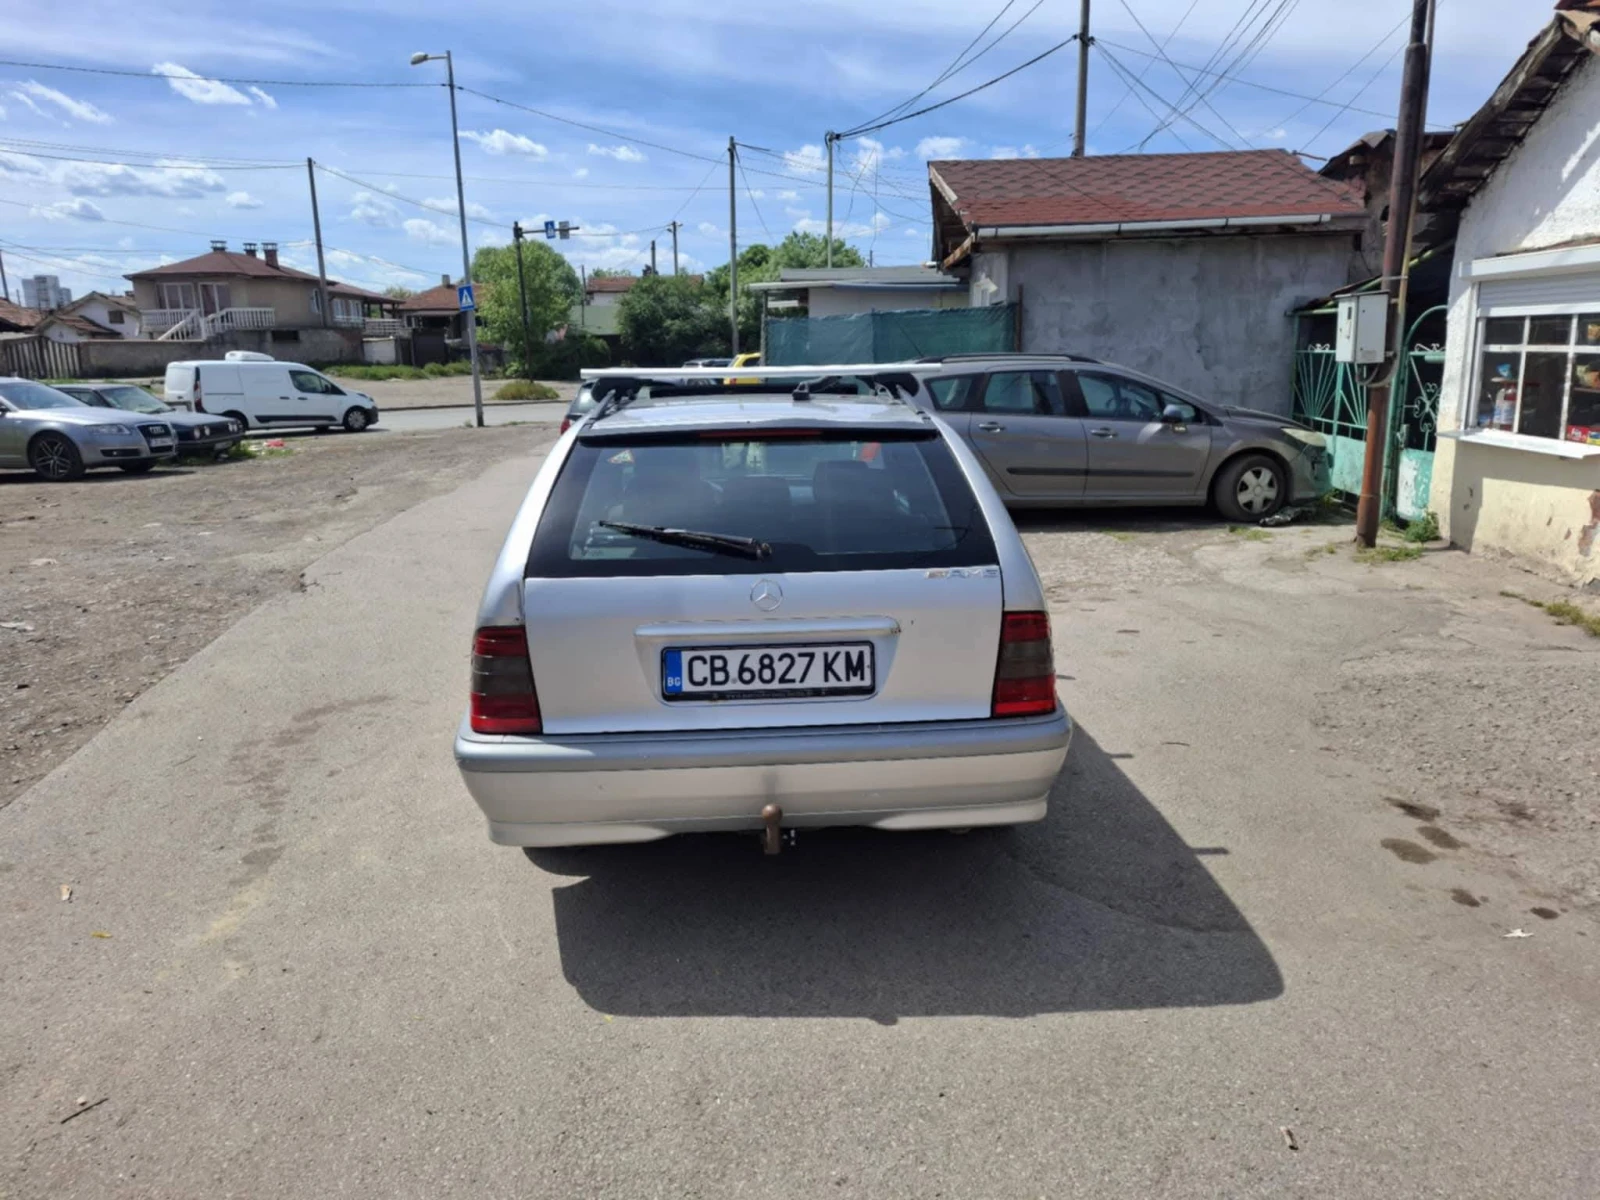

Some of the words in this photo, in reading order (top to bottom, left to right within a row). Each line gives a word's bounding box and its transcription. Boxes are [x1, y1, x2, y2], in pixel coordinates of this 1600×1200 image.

[688, 655, 730, 687] CB
[737, 652, 816, 686] 6827
[823, 651, 865, 683] KM
[667, 676, 681, 687] BG
